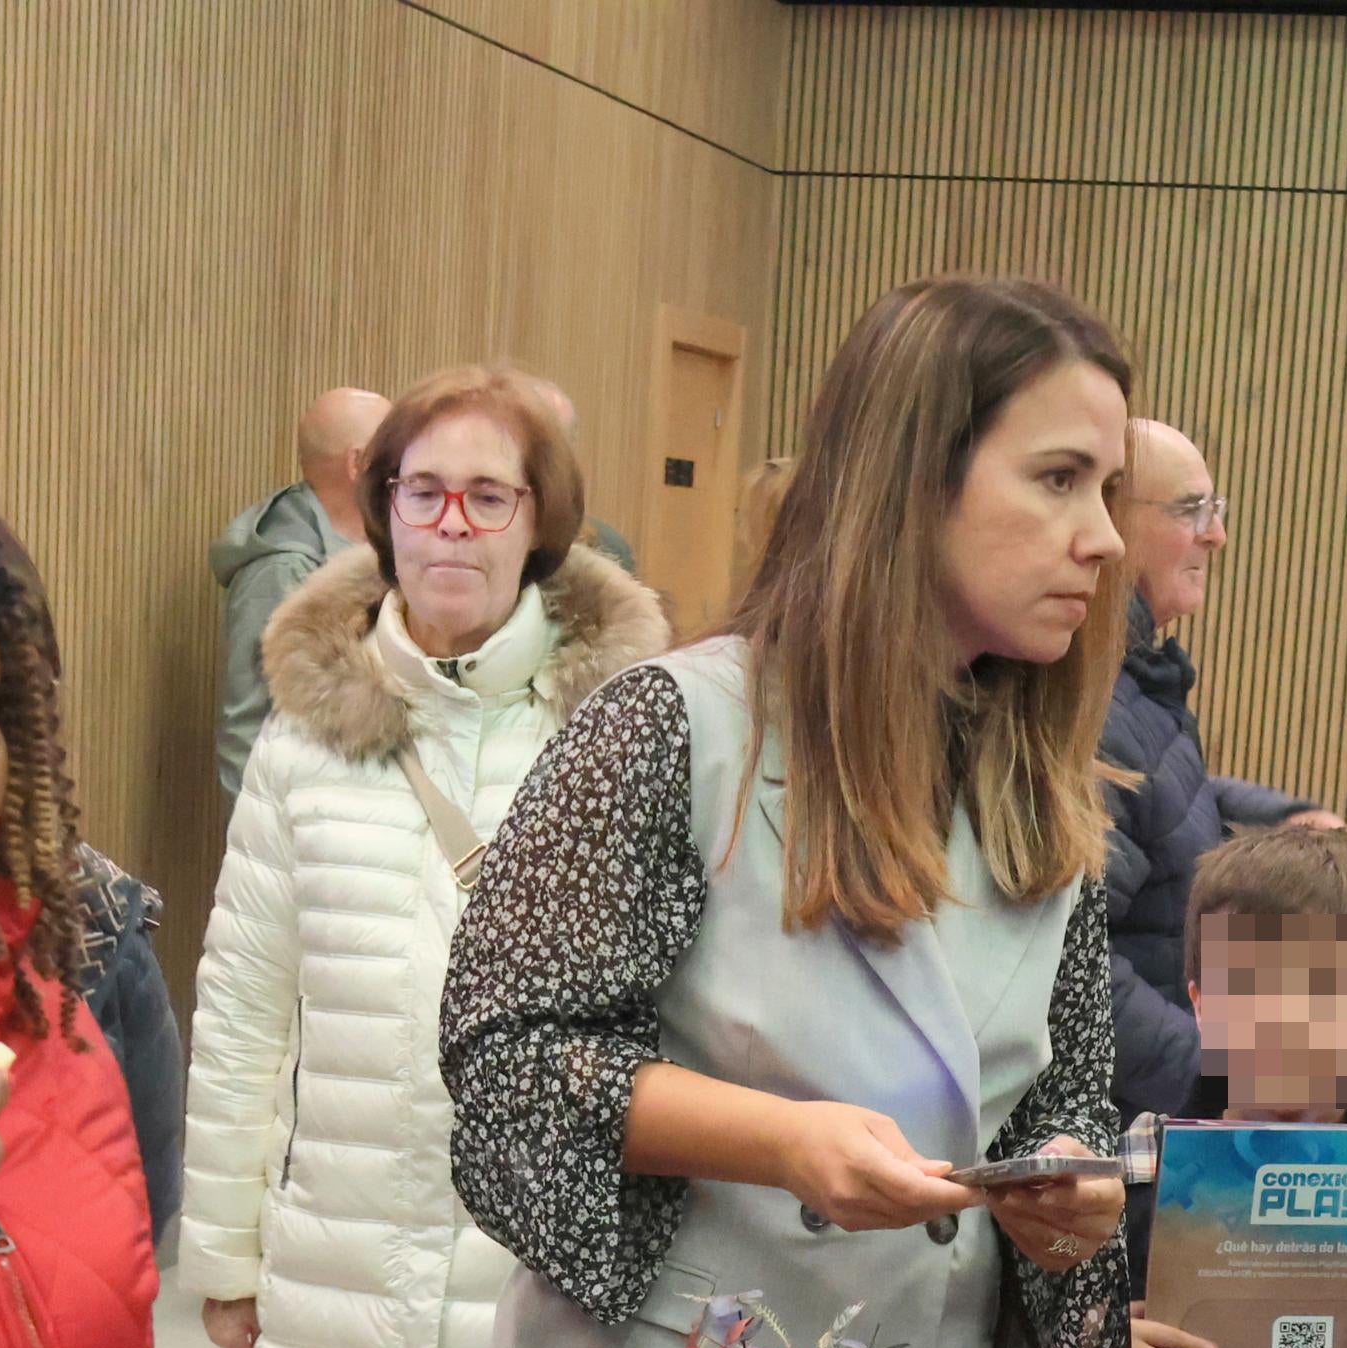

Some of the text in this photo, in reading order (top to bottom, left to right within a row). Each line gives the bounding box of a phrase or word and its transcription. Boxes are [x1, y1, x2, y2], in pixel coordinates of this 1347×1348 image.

[1217, 1240, 1248, 1255] ¿Qué
[1251, 1241, 1272, 1255] hay
[1276, 1240, 1316, 1254] detrás
[1319, 1241, 1334, 1254] de
[1337, 1241, 1347, 1254] la
